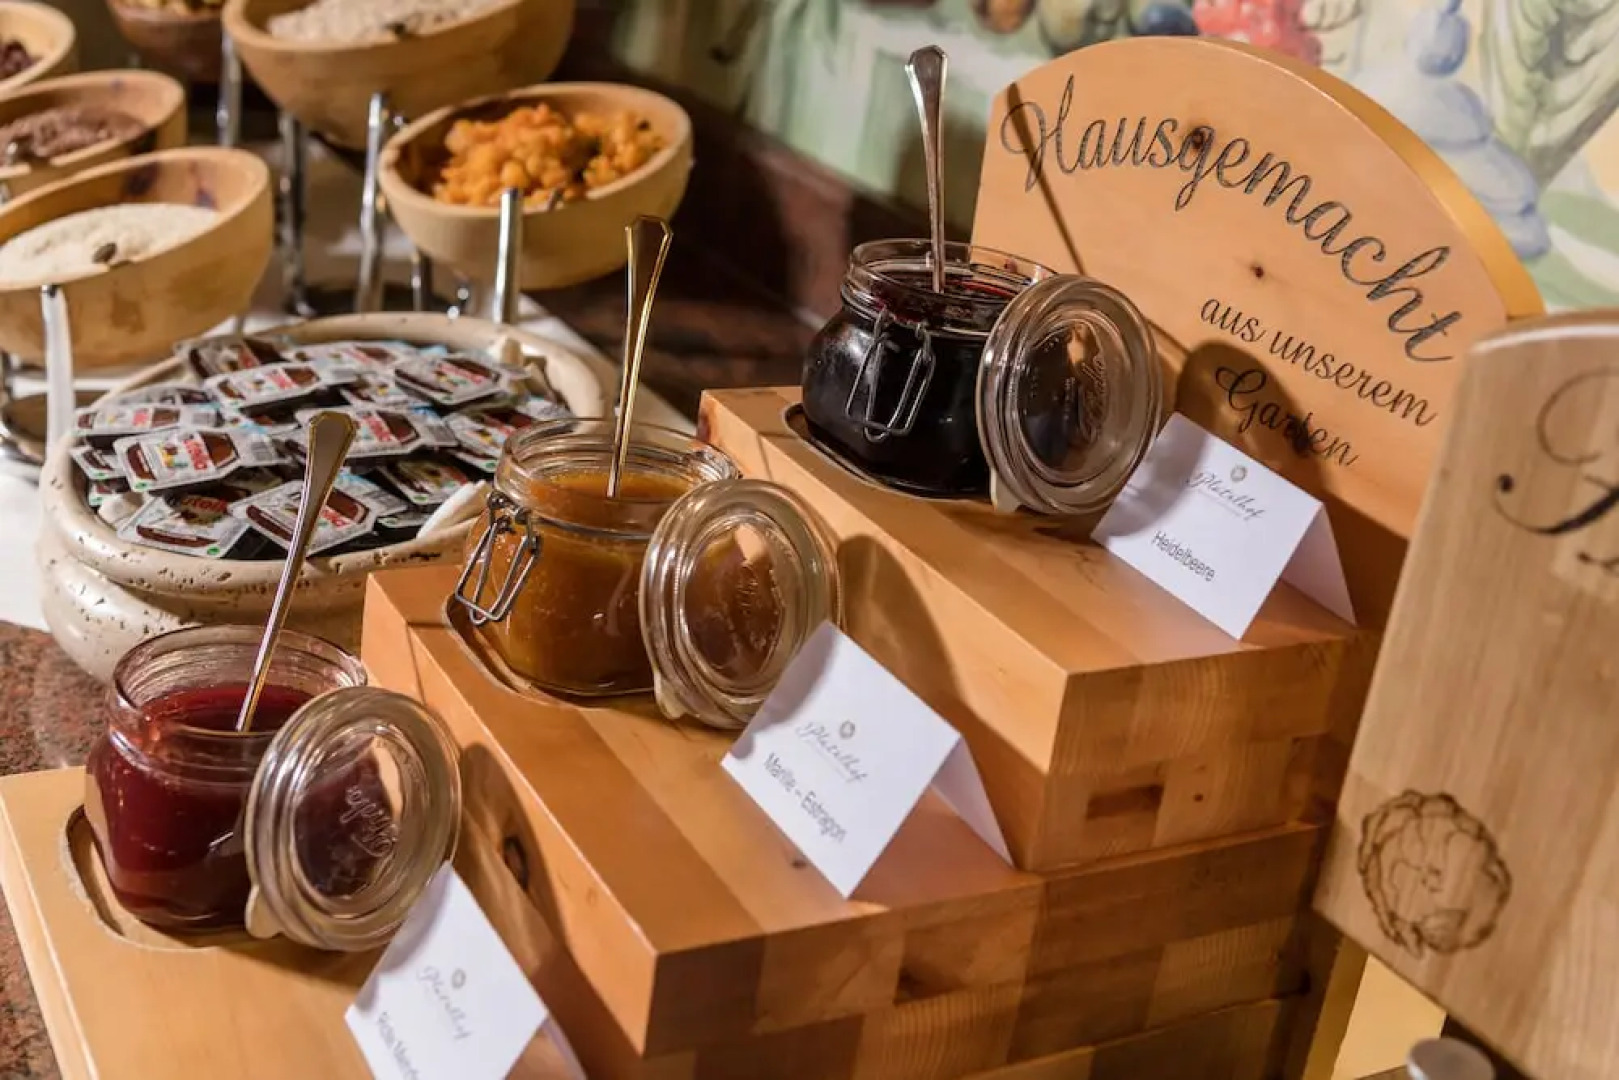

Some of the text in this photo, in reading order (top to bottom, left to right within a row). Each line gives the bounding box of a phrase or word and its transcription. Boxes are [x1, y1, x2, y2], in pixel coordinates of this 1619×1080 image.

[1000, 73, 1461, 363] Hausgemacht
[1200, 297, 1440, 427] aus unserem
[1214, 365, 1361, 467] Garten
[1151, 530, 1216, 583] Heidelbeere
